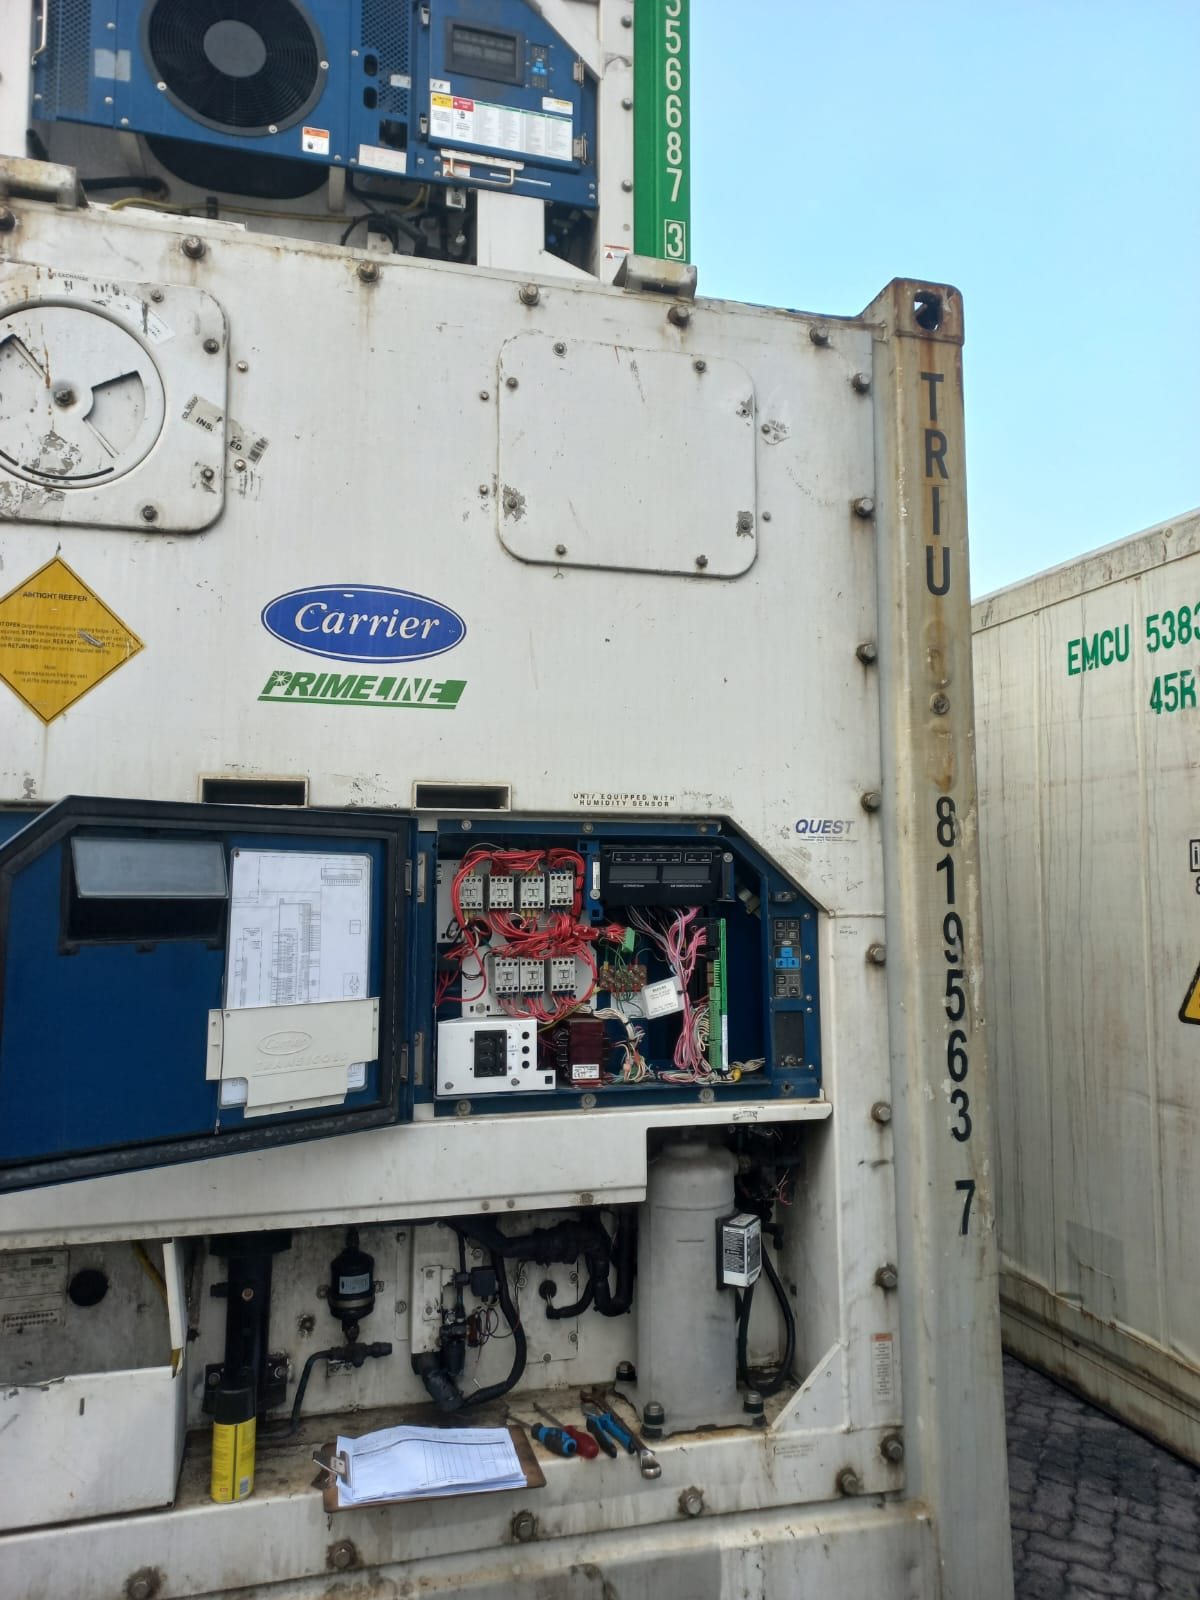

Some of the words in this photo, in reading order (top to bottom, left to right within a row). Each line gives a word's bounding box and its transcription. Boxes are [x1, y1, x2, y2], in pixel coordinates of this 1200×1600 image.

[667, 223, 684, 257] 3
[920, 372, 951, 596] TRIU
[294, 602, 440, 640] Carrier
[1067, 624, 1130, 676] EMCU
[601, 793, 647, 801] EQUIPPED
[795, 818, 856, 834] QUEST
[936, 796, 973, 1142] 819563
[955, 1179, 976, 1235] 7
